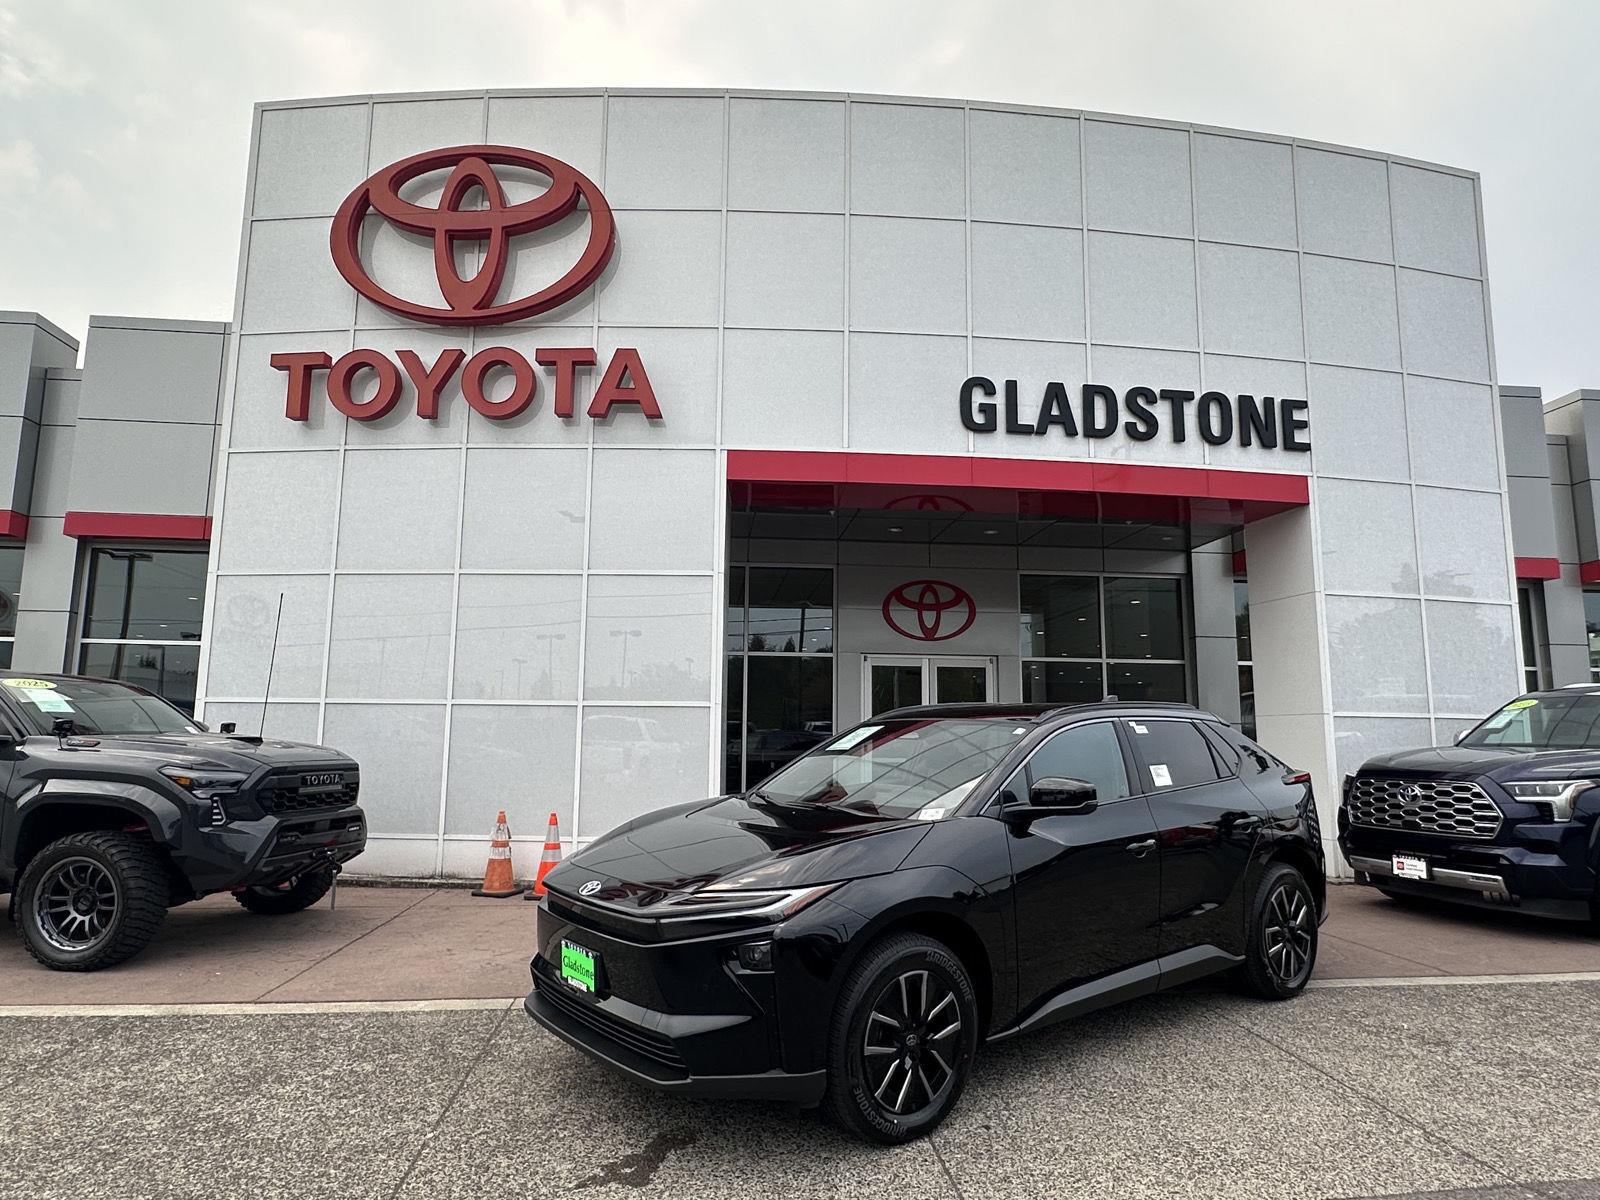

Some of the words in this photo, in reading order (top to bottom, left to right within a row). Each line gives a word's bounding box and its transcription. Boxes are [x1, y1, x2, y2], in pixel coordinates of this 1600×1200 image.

[270, 346, 663, 421] TOYOTA
[960, 376, 1311, 452] GLADSTONE
[305, 774, 342, 785] TOYOTA
[562, 955, 595, 982] Gladstone
